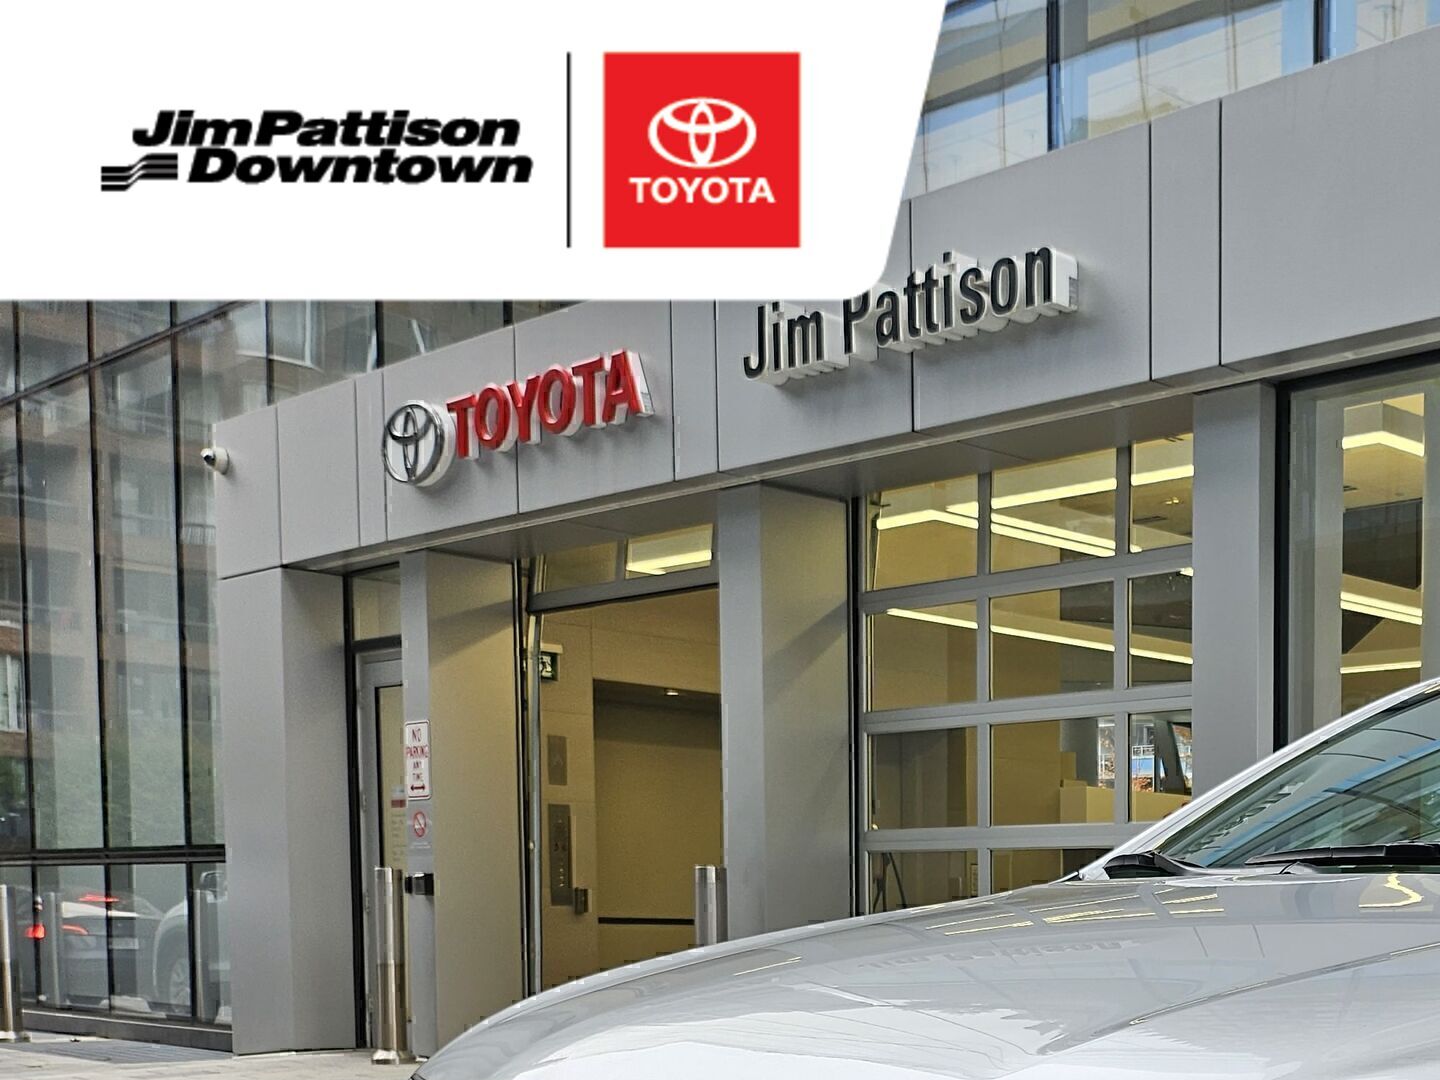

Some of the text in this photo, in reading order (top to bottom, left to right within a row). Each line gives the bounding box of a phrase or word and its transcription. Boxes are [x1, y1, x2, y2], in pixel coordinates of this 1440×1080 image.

[743, 246, 1058, 380] Jim Pattison
[446, 348, 646, 459] TOYOTA
[411, 728, 422, 742] NO
